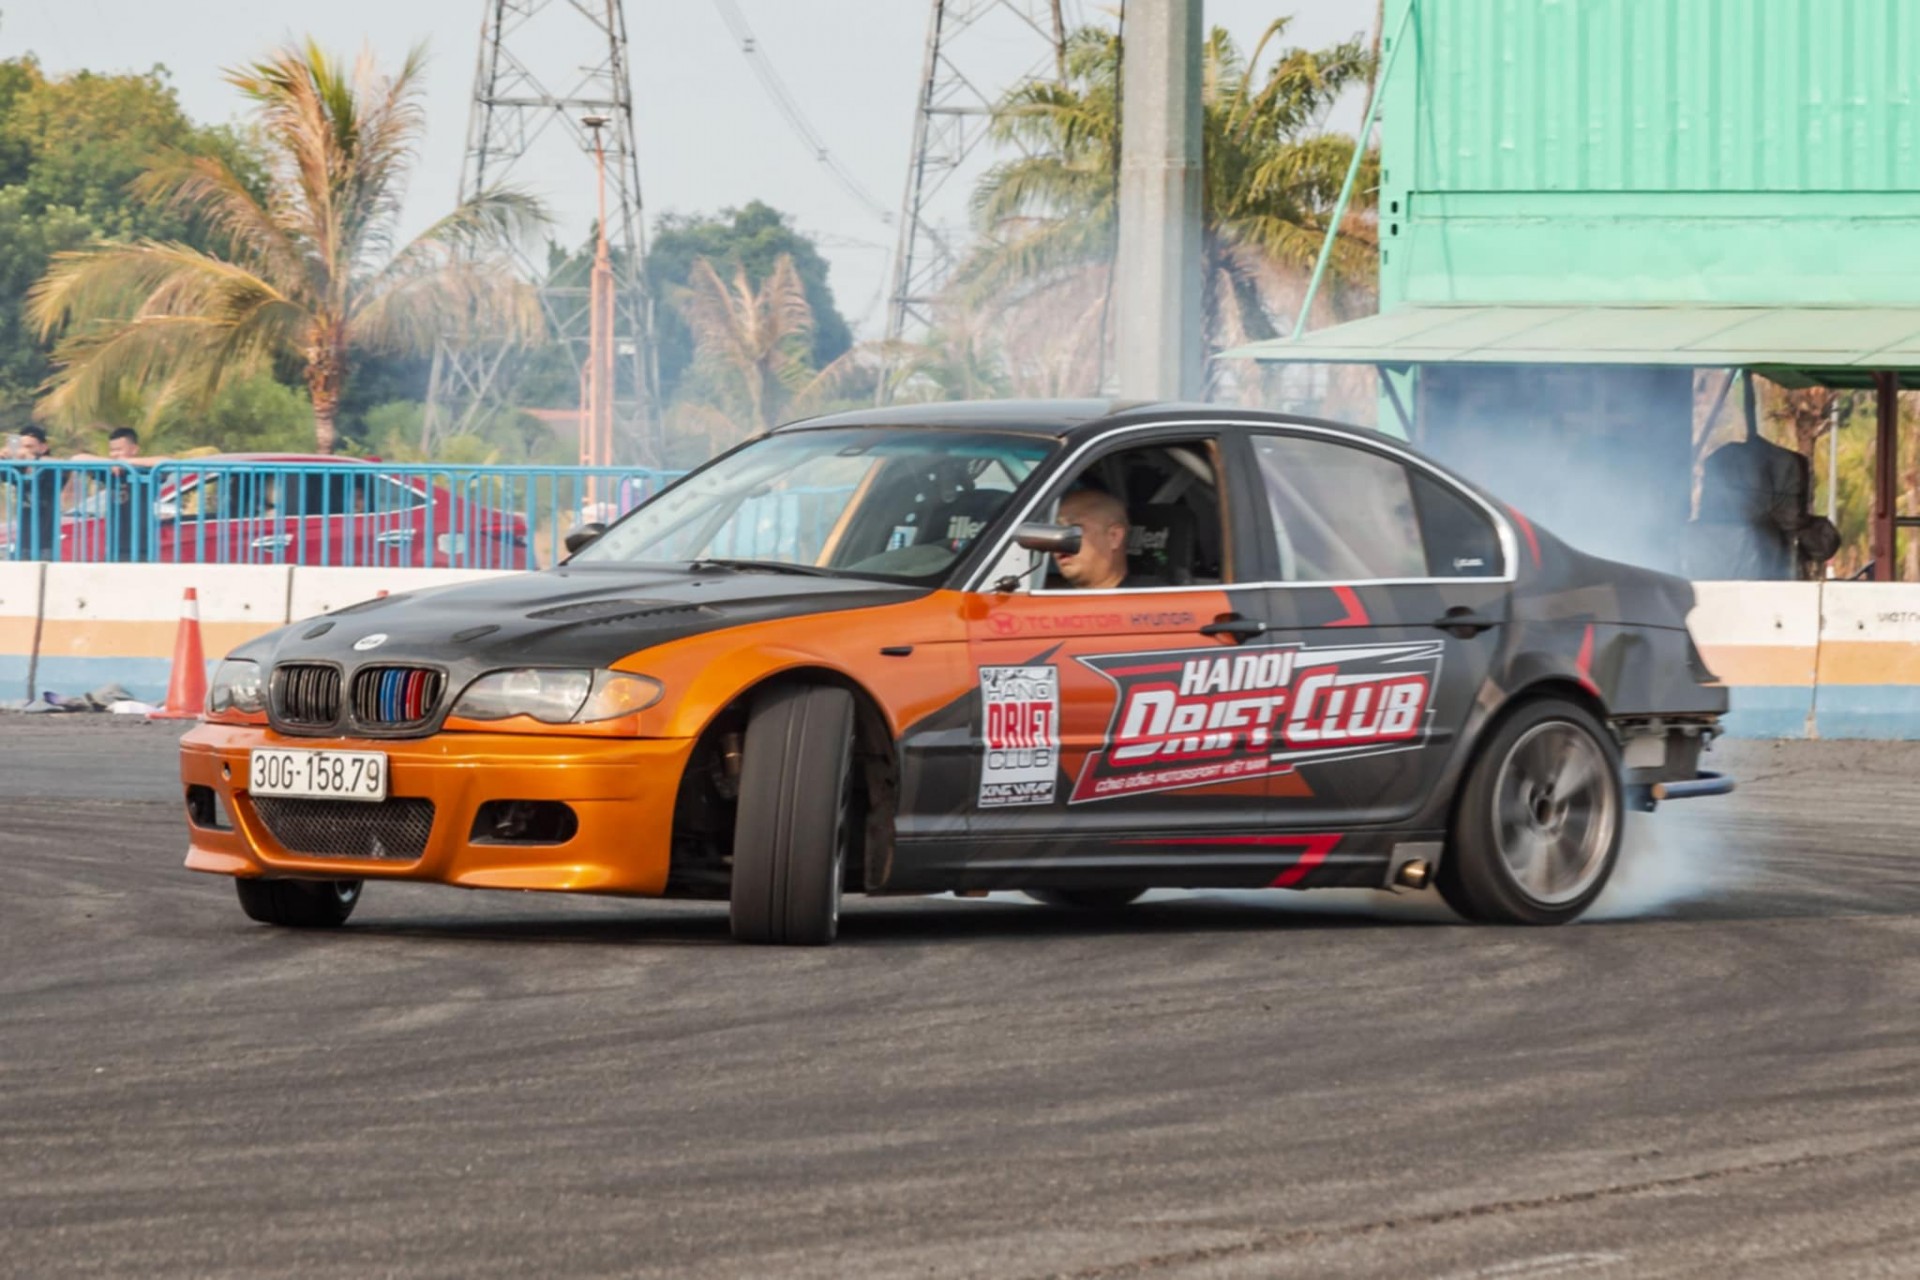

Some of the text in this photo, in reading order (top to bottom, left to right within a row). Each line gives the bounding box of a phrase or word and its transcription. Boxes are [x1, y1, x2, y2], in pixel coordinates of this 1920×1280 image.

[1054, 614, 1122, 629] MOTOR
[1131, 611, 1195, 626] HYUNDAI
[1179, 651, 1295, 696] HANOI
[987, 702, 1053, 749] DRIFT
[1112, 673, 1425, 759] DRIFT CLUB
[254, 754, 380, 793] 30G-158.79
[987, 748, 1051, 770] CLUB
